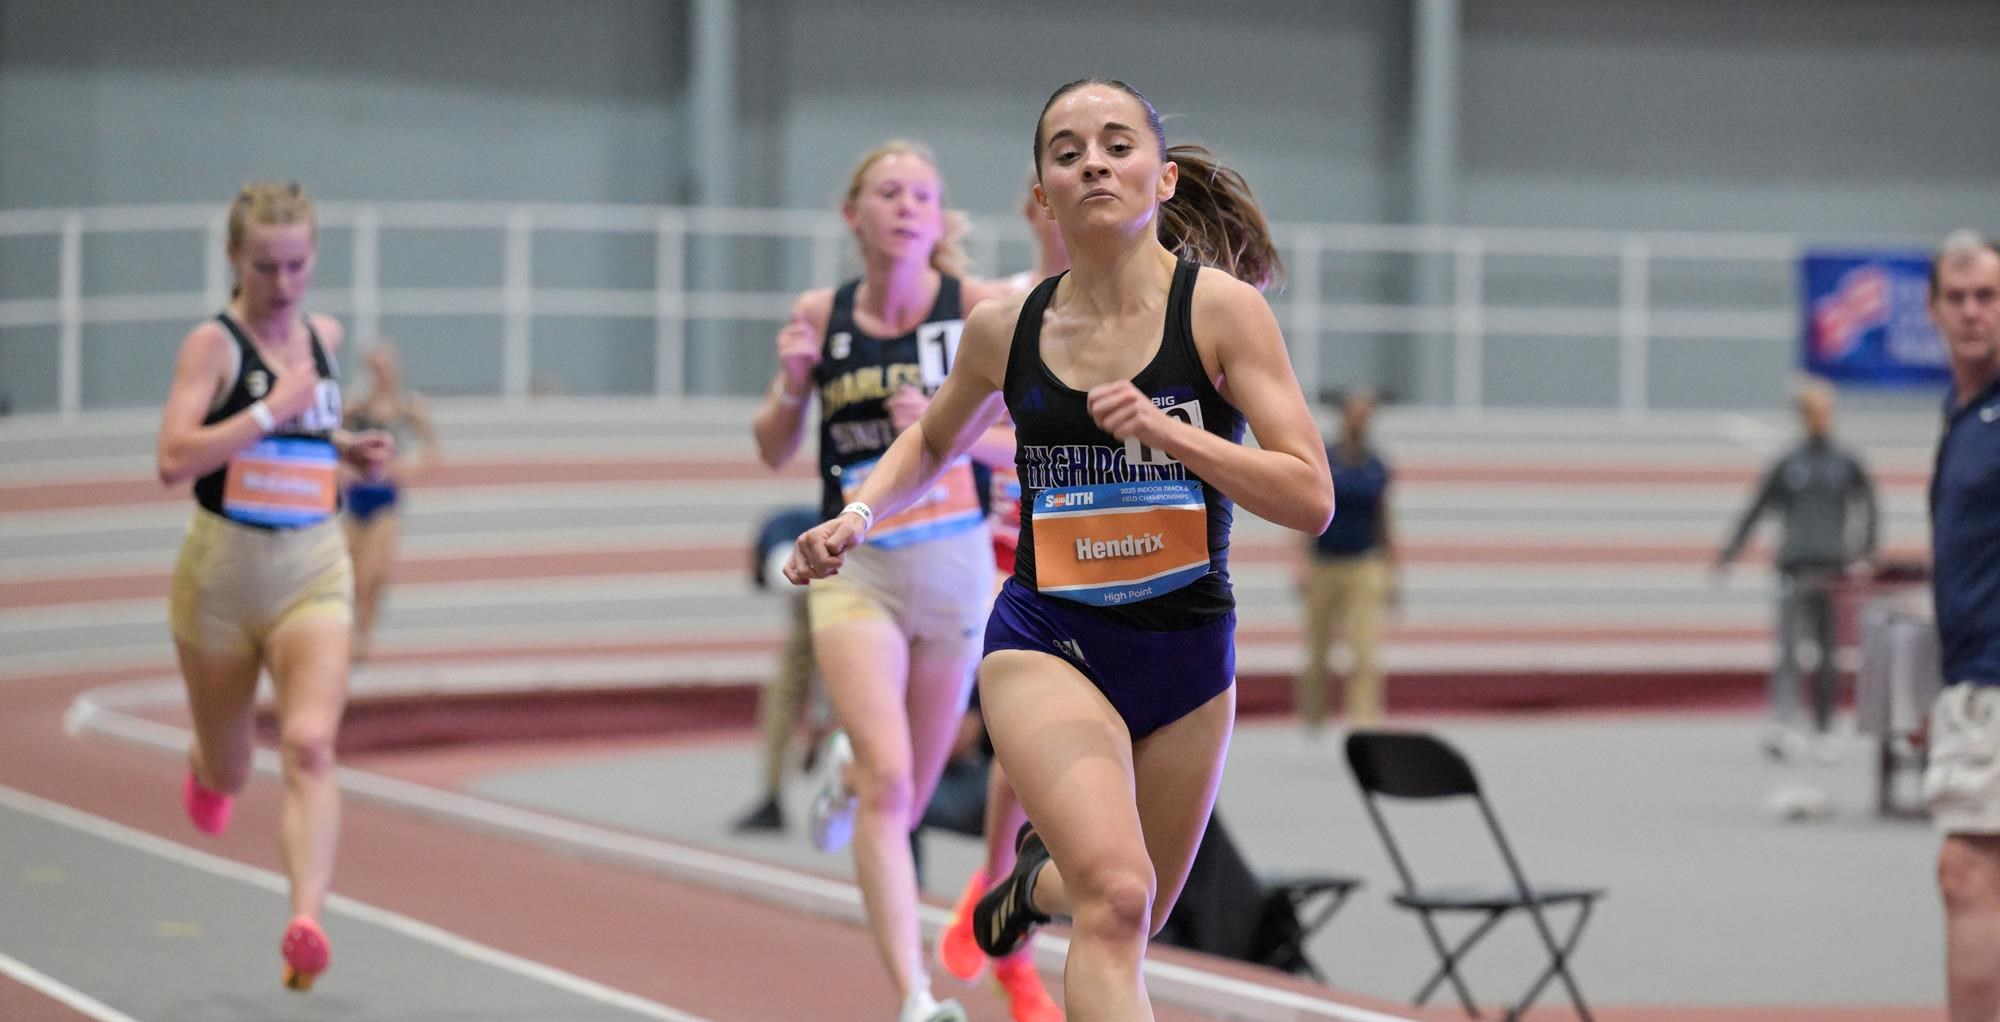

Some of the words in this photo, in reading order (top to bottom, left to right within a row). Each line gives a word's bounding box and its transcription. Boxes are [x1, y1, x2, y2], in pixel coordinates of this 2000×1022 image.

[1152, 395, 1175, 408] BIG
[1024, 444, 1089, 489] HIGH
[1139, 493, 1189, 502] CHAMPIONSHIPS
[1076, 532, 1164, 560] Hendrix
[1104, 588, 1127, 603] High
[1128, 586, 1153, 599] Point
